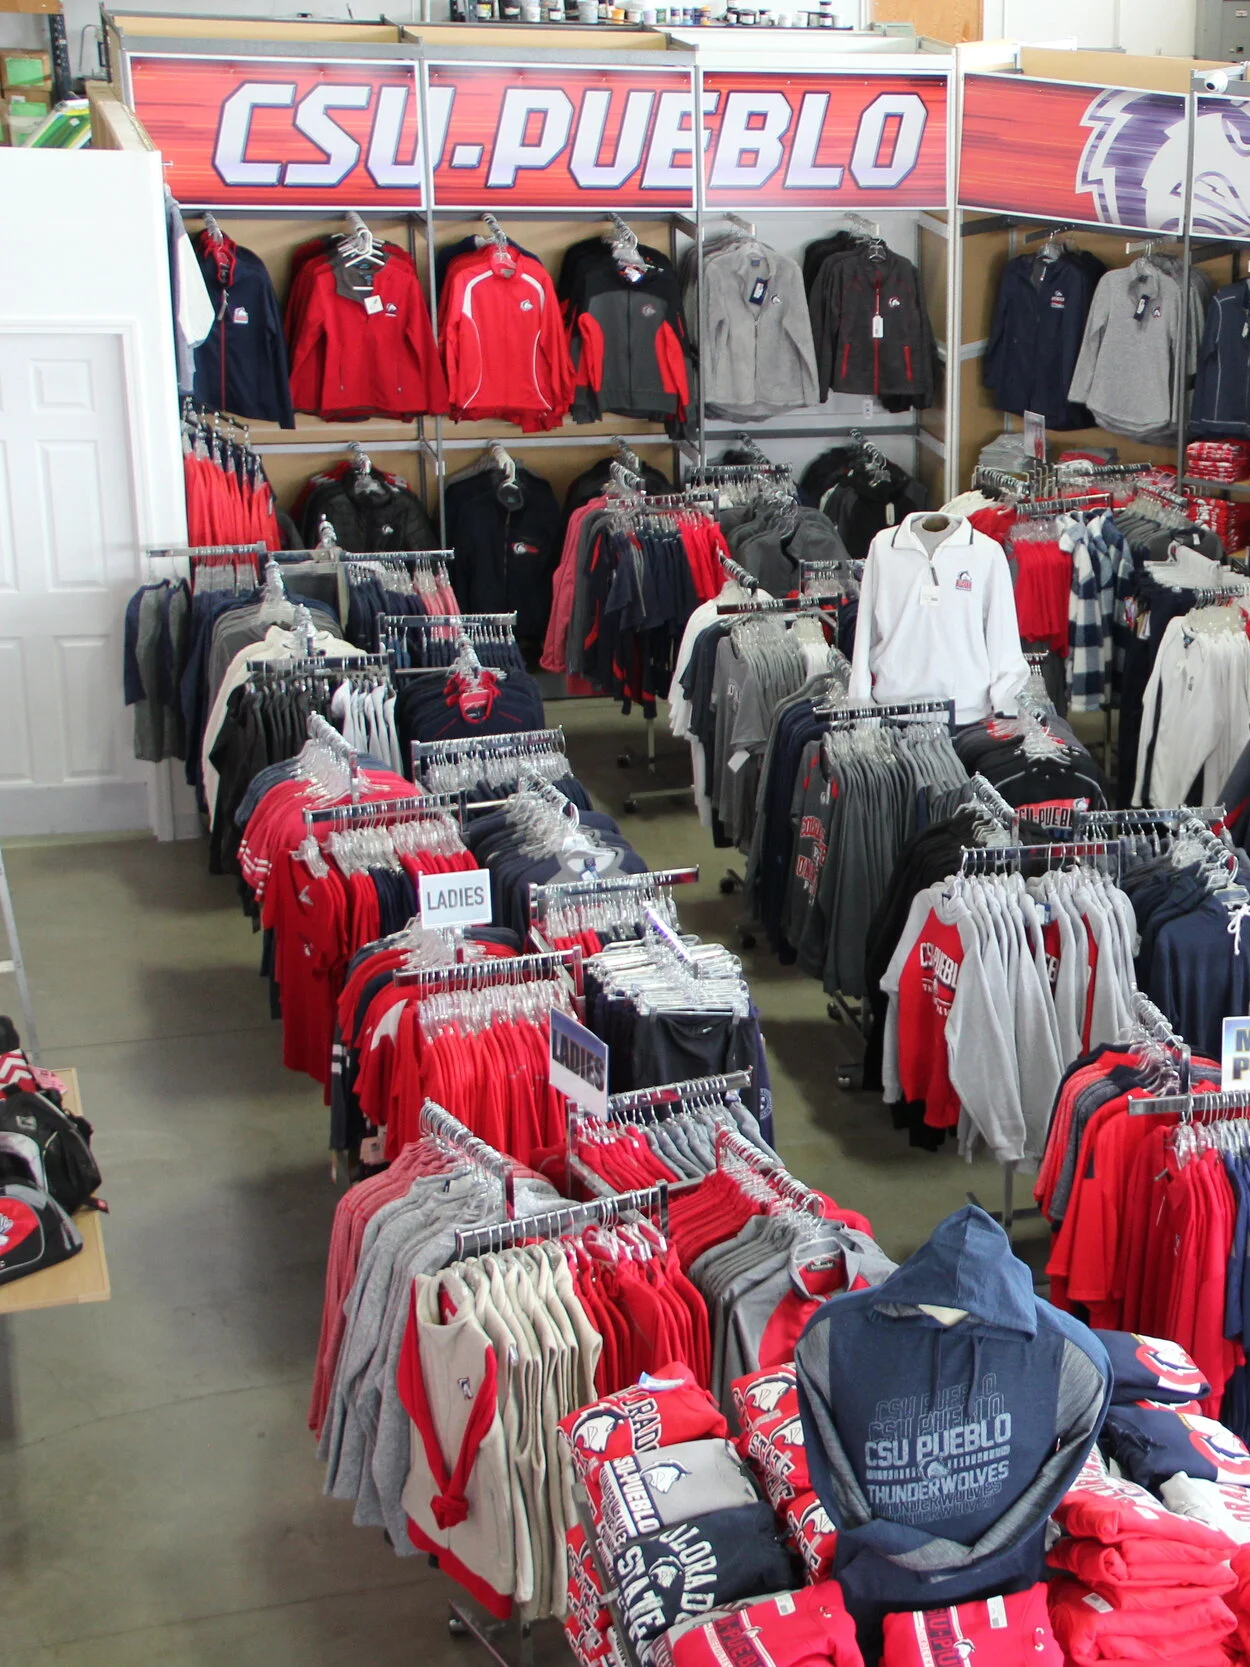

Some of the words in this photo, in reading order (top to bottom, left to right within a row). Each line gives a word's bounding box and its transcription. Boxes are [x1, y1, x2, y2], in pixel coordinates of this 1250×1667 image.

[212, 80, 929, 191] CSU-PUEBLO
[427, 886, 484, 911] LADIES
[552, 1027, 605, 1093] LADIES
[864, 1439, 909, 1467] CSU
[915, 1412, 1012, 1464] PUEBLO
[612, 1455, 662, 1535] SU-PUEBLO
[866, 1459, 1010, 1504] THUNDERWOLVES
[617, 1545, 666, 1641] STATE
